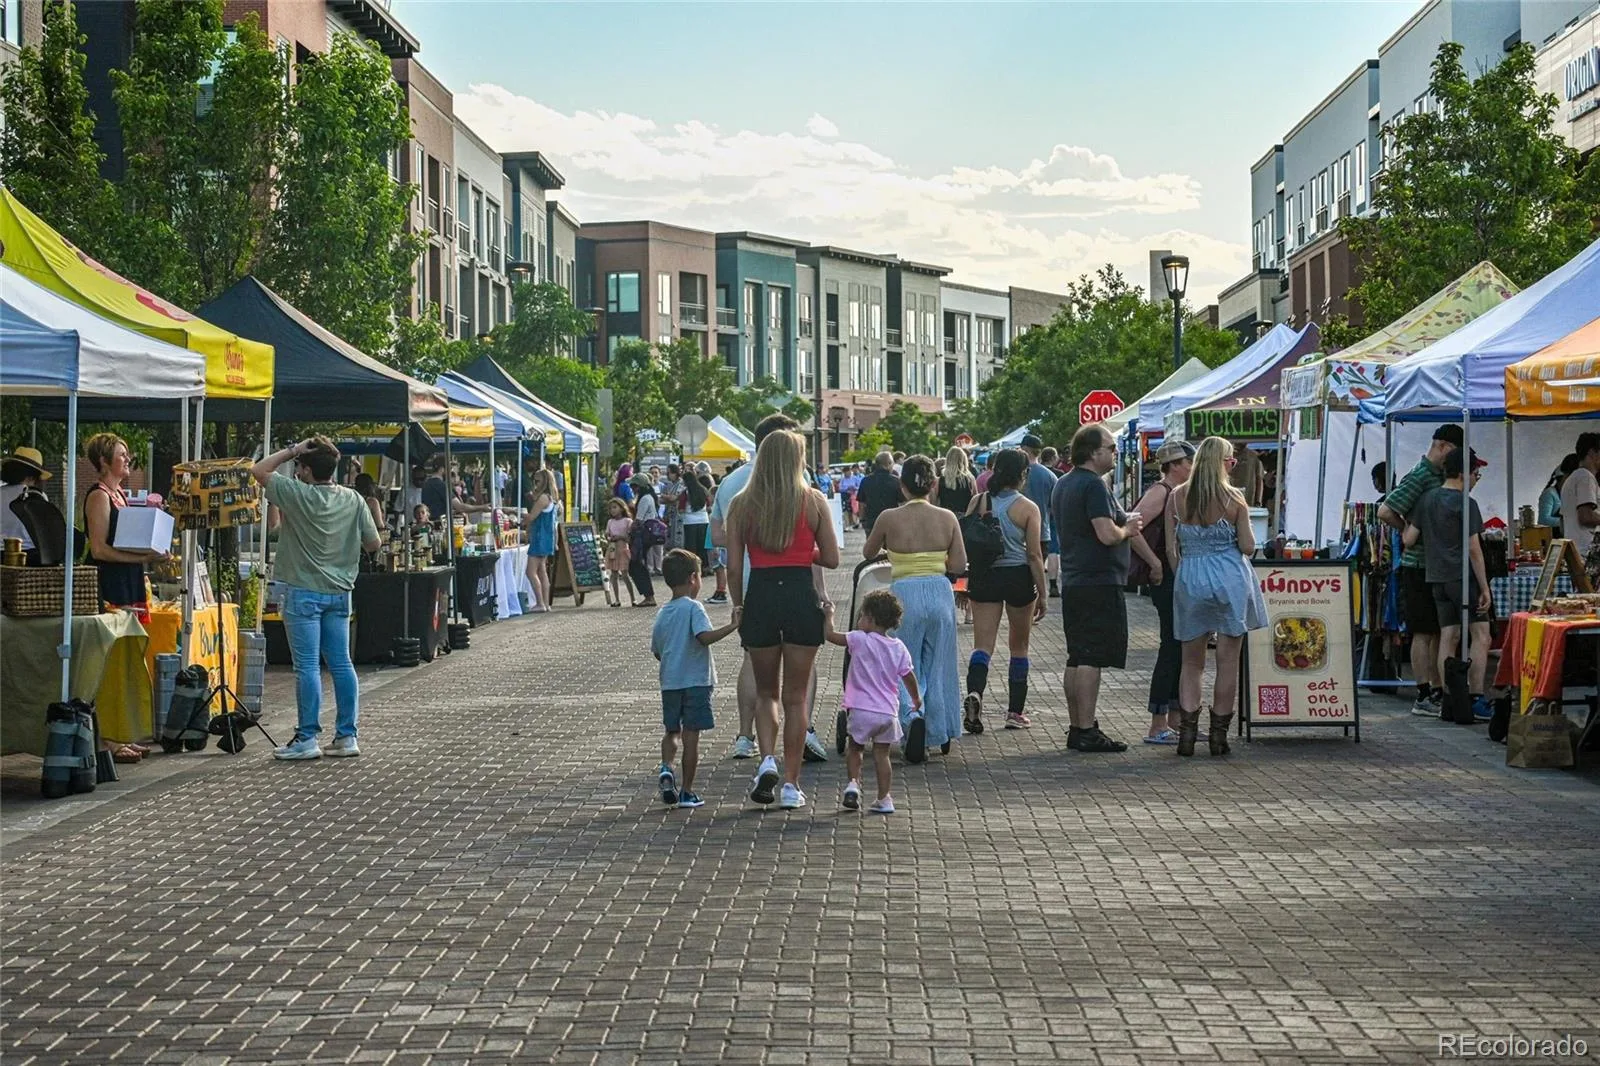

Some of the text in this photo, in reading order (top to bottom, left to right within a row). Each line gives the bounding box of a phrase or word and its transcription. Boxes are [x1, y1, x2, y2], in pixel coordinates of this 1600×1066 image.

[1564, 48, 1598, 101] ORIGIN
[1236, 396, 1267, 406] IN
[1083, 405, 1121, 421] STOP
[1190, 409, 1278, 437] PICKLES
[1269, 598, 1295, 606] Biryanis
[1307, 677, 1339, 691] eat
[1308, 694, 1339, 704] one
[1308, 704, 1349, 717] now!
